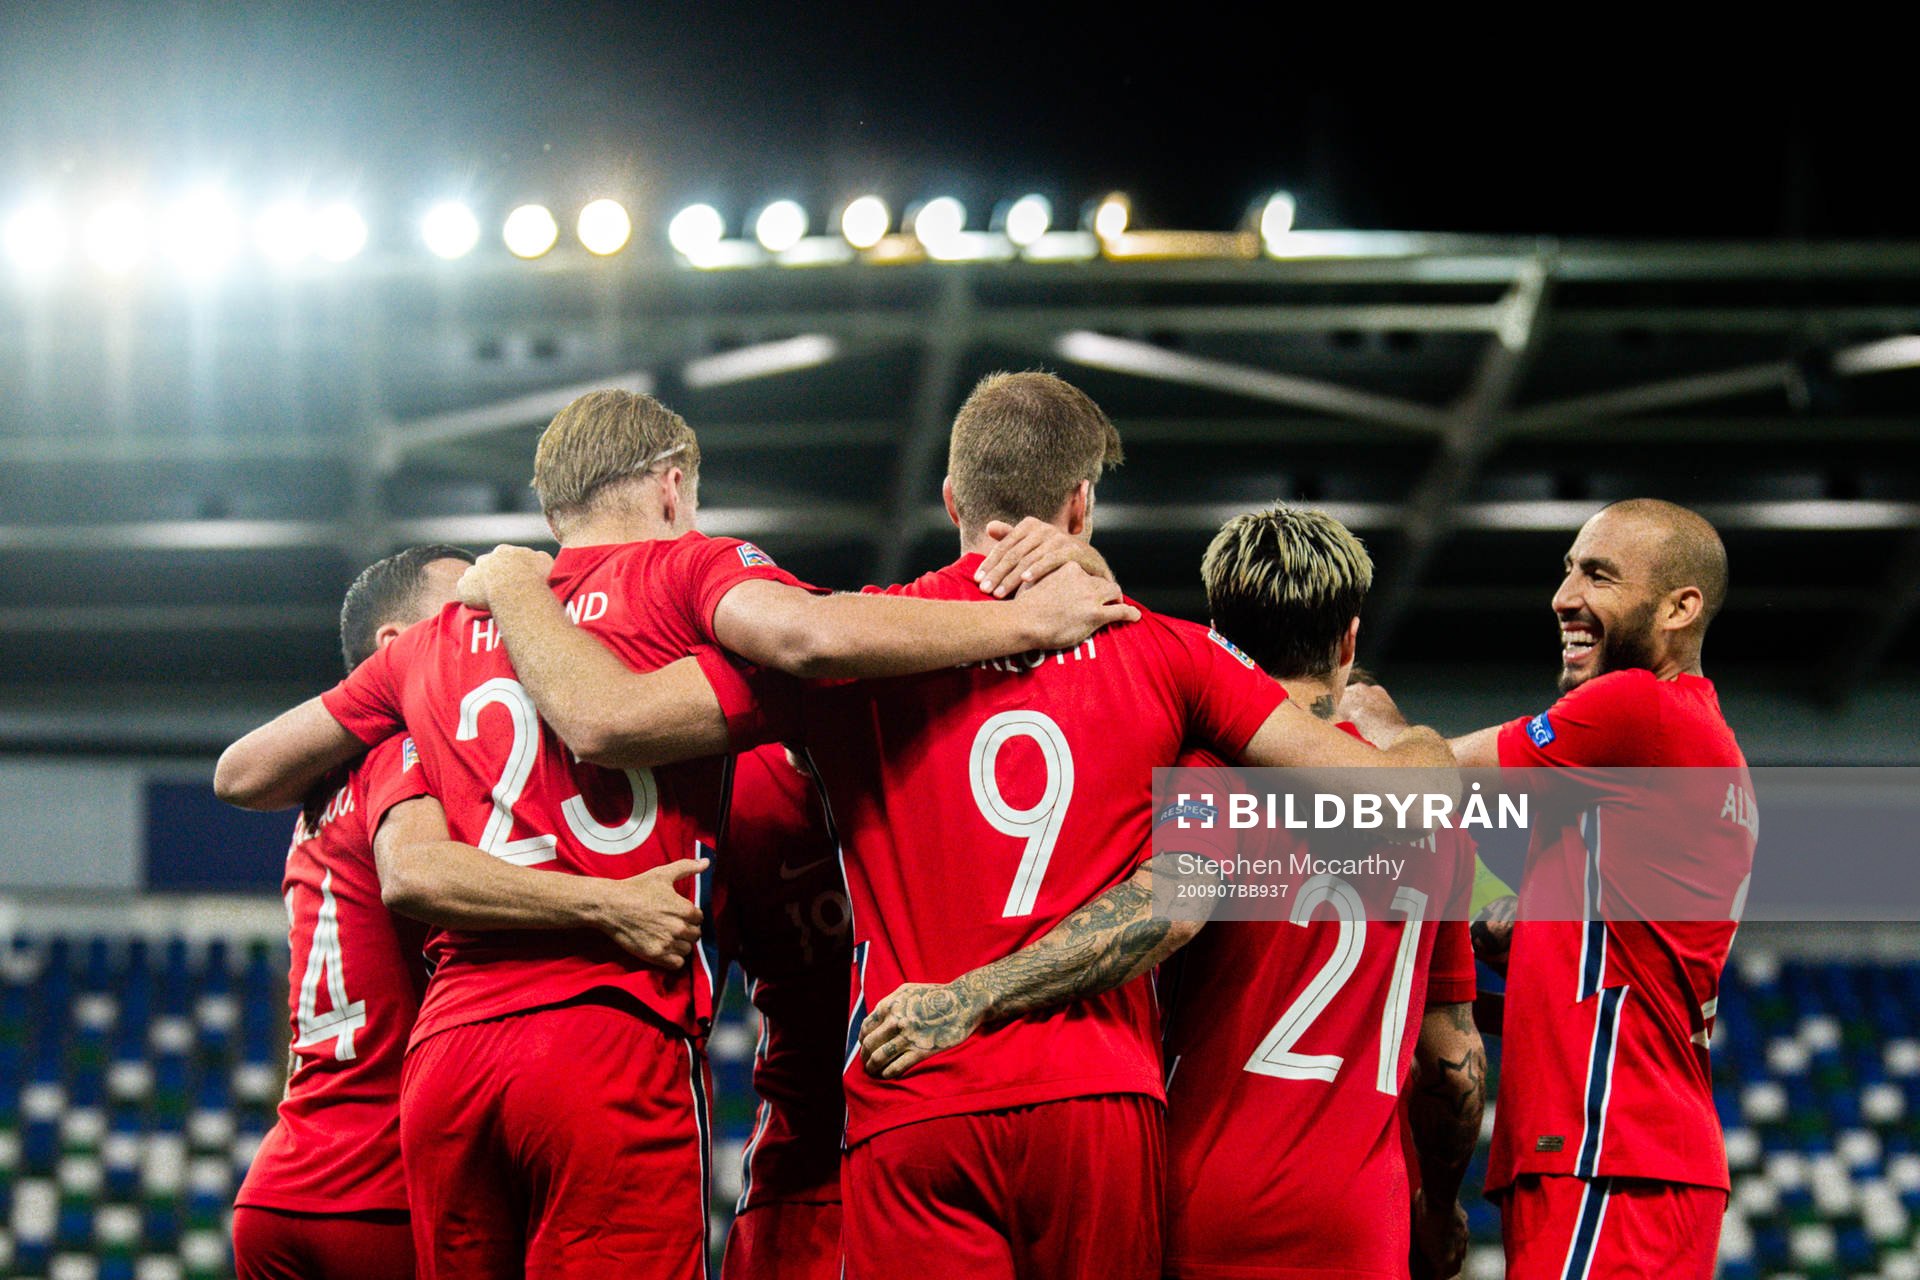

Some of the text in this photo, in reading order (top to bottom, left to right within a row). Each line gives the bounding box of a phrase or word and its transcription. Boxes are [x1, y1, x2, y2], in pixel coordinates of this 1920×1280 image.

[969, 710, 1074, 918] 9
[1160, 804, 1218, 821] RESPECT
[1243, 873, 1429, 1097] 21
